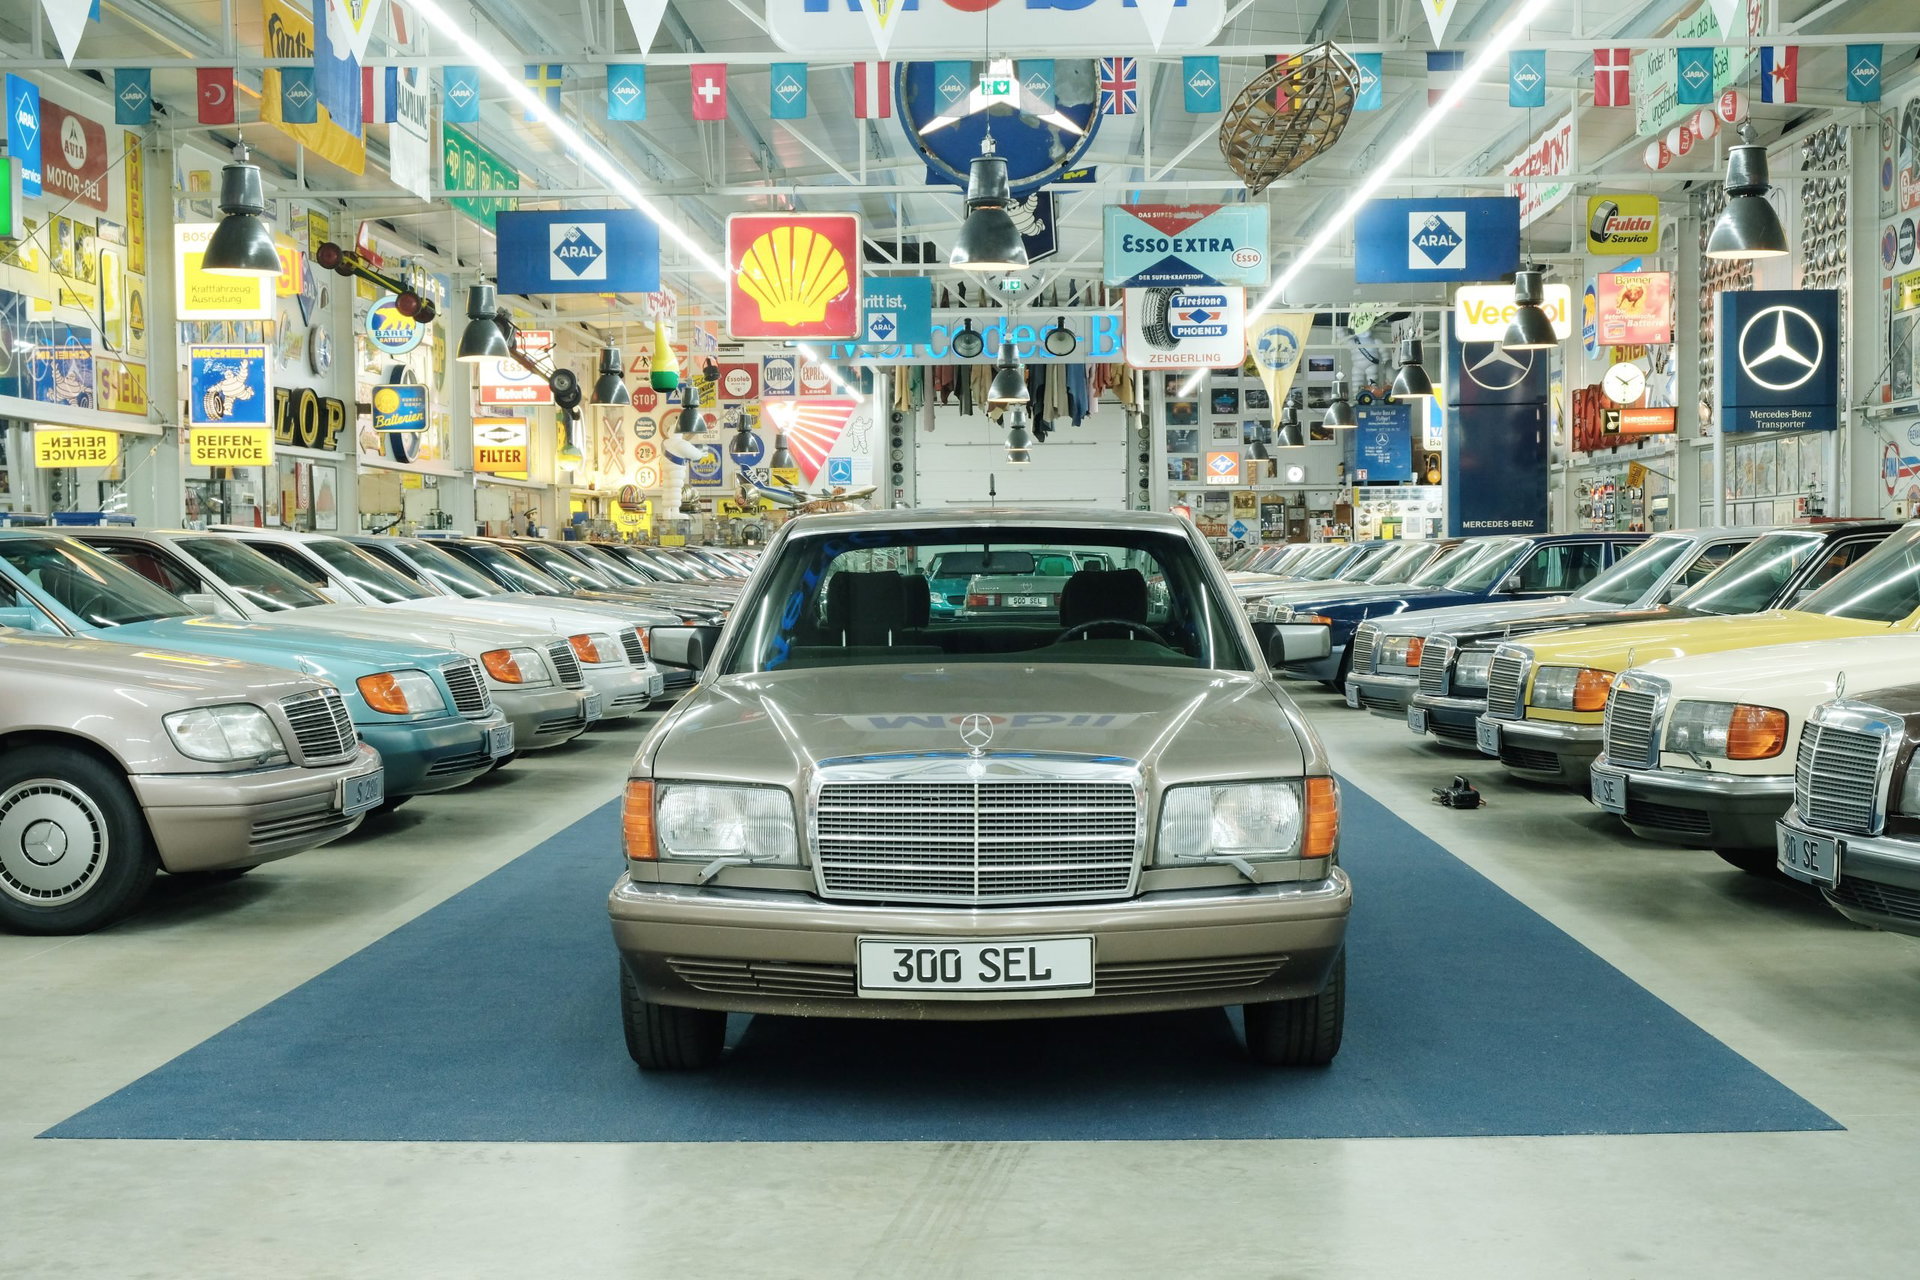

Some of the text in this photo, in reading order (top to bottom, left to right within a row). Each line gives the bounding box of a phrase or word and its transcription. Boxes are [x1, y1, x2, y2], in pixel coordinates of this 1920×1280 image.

[64, 140, 84, 159] AVIA
[1605, 217, 1651, 231] Fulda
[1173, 238, 1234, 252] EXTRA
[1418, 235, 1457, 247] ARAL
[1611, 235, 1649, 243] Service
[559, 246, 598, 258] ARAL
[863, 294, 907, 311] ritt ist,
[1177, 296, 1222, 306] Firestone
[1463, 299, 1565, 326] Veeol
[1177, 327, 1222, 335] PHOENIX
[192, 349, 264, 359] MICHELIN
[1150, 354, 1221, 363] ZENGERLING
[766, 367, 793, 381] EXPRESS
[633, 397, 656, 405] STOP
[275, 386, 345, 449] LOP
[374, 411, 424, 428] Batterien
[1750, 410, 1812, 419] Mercedes-Benz
[1756, 420, 1806, 430] Transporter
[197, 435, 262, 446] REIFEN-
[197, 448, 263, 459] SERVICE
[480, 449, 521, 463] FILTER
[1210, 475, 1236, 484] FOTO
[1029, 597, 1042, 605] SEL
[1603, 780, 1616, 803] SE
[1803, 839, 1820, 872] SE
[893, 946, 1052, 983] 300 SEL
